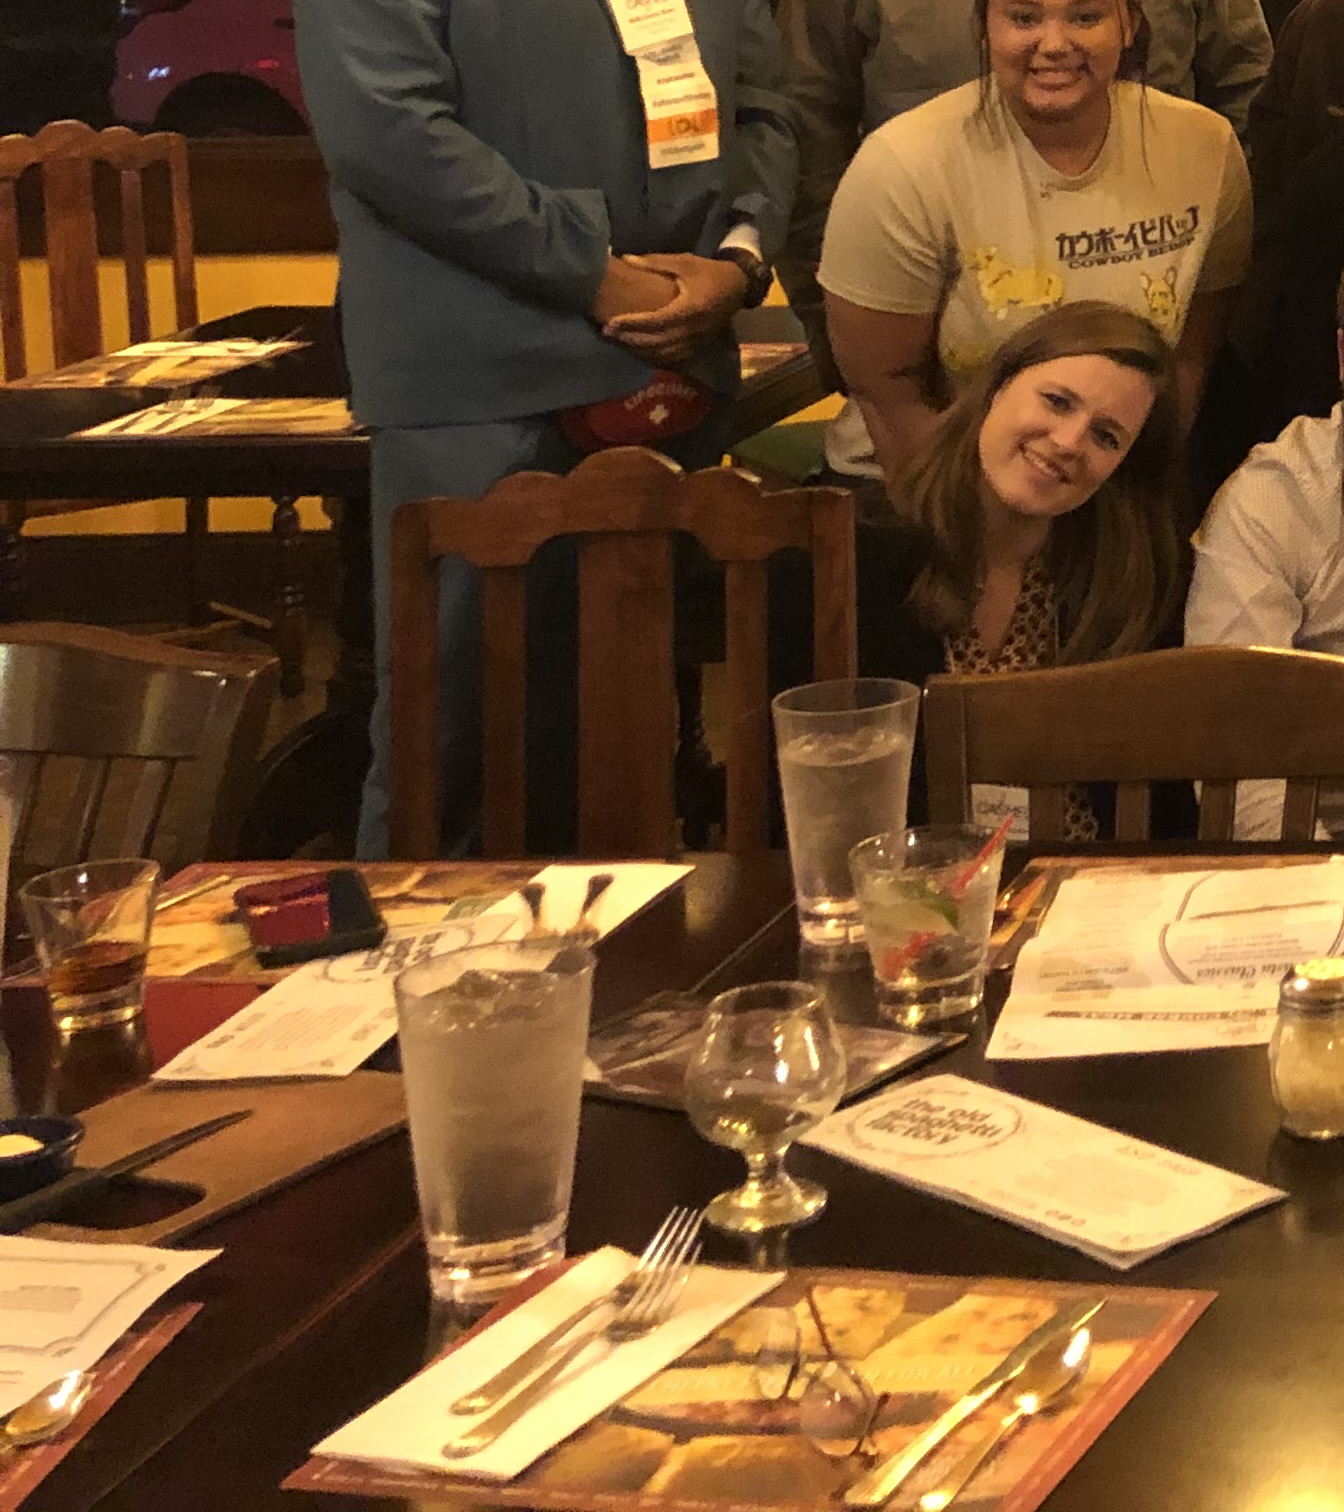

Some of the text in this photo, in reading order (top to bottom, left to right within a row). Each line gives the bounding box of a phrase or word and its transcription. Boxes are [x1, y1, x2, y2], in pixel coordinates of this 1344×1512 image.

[1068, 250, 1142, 269] COWBOY
[903, 1097, 993, 1123] the old
[888, 1110, 1002, 1139] spaghetti
